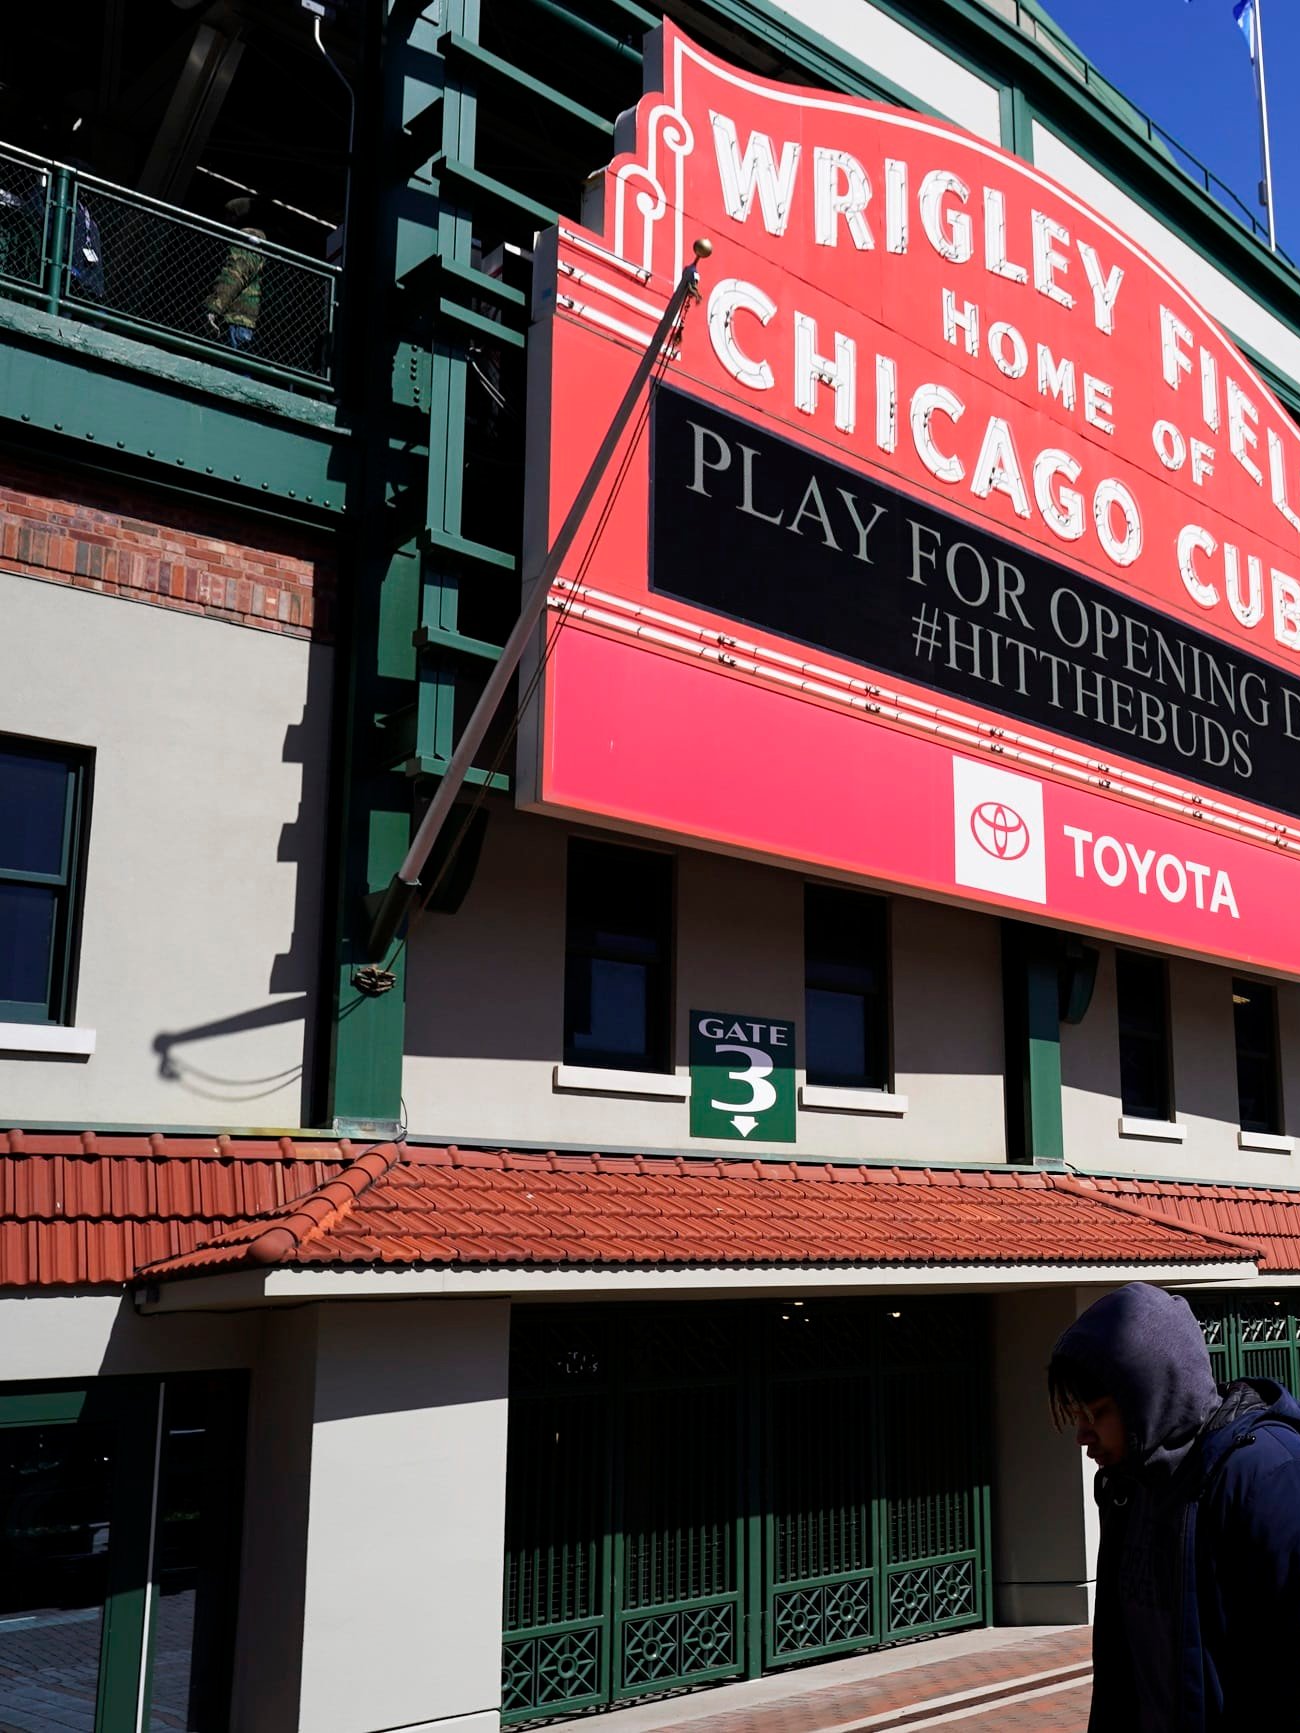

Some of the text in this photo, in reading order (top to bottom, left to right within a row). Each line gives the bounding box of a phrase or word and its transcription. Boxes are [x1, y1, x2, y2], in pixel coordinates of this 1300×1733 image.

[708, 109, 1125, 336] WRIGLEY
[707, 279, 1144, 567] CHICAGO
[942, 288, 1216, 486] HOME OF
[686, 419, 889, 565] PLAY
[905, 518, 1035, 631] FOR
[1050, 587, 1270, 727] OPENING
[911, 602, 1252, 778] #HITTHEBUDS
[1063, 824, 1240, 919] TOYOTA
[698, 1018, 788, 1047] GATE
[711, 1044, 777, 1113] 3
